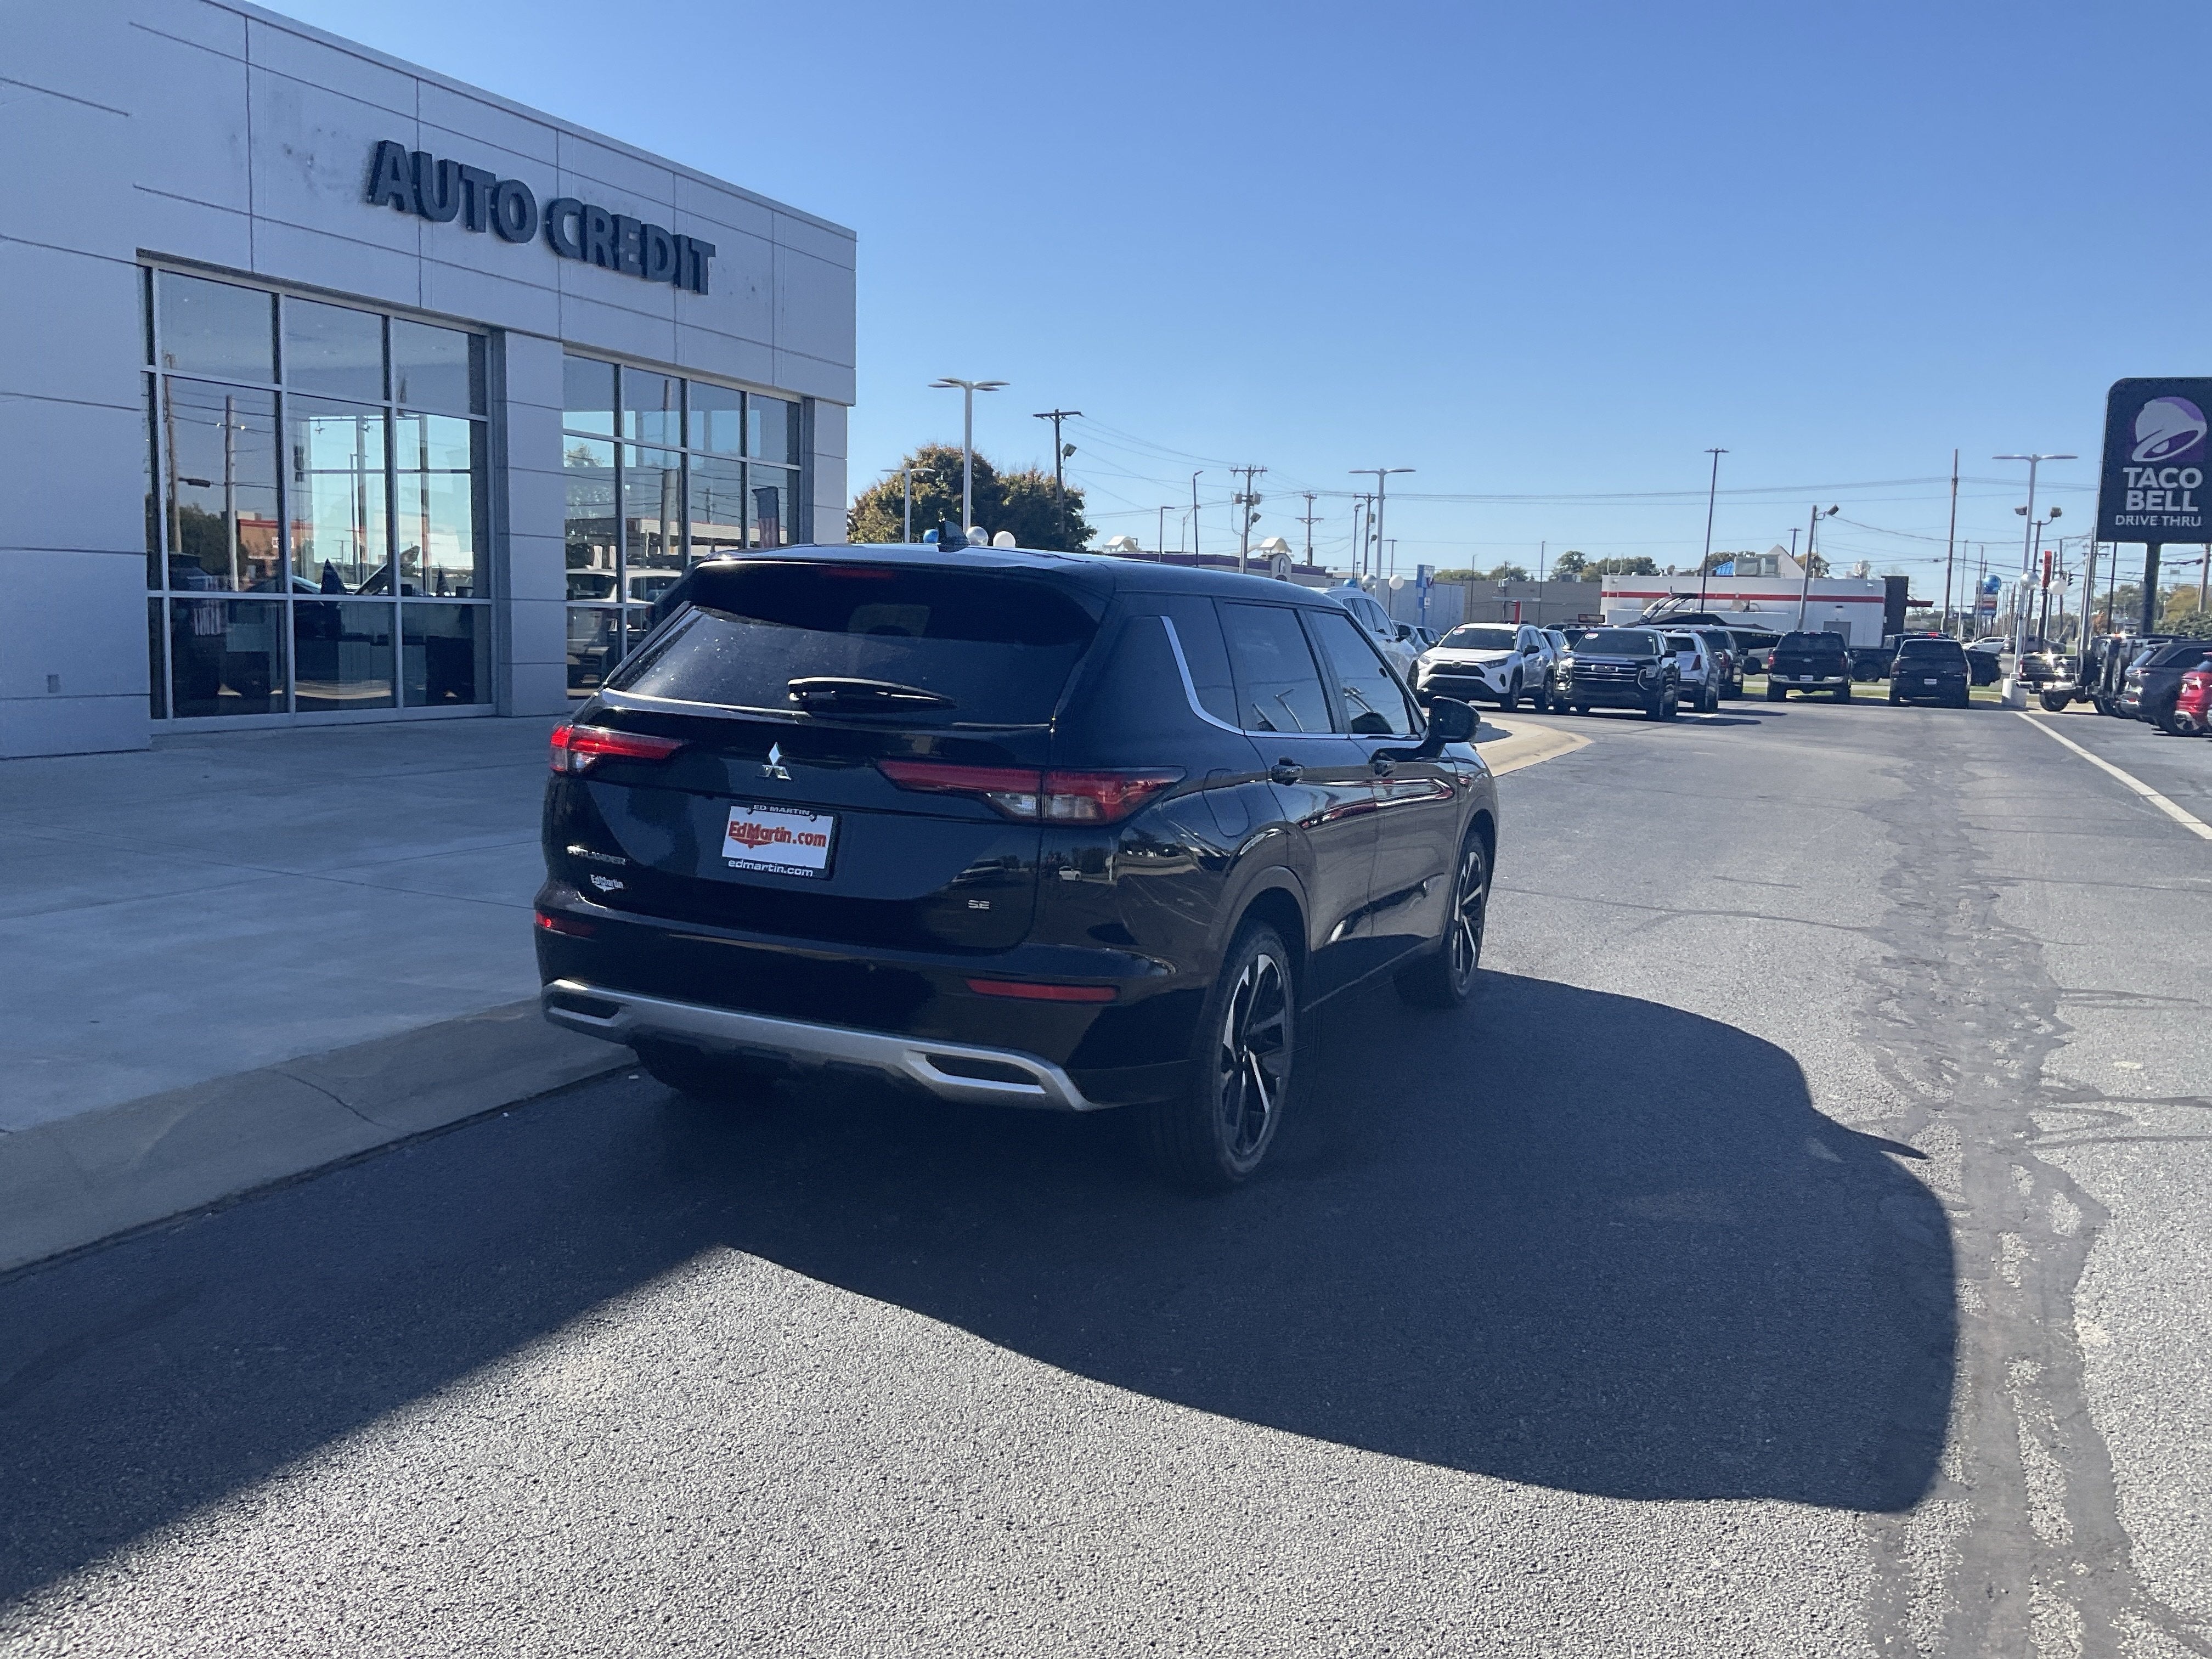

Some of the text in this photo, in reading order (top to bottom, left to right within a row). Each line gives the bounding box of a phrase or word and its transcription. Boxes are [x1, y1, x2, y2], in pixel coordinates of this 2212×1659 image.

[366, 140, 715, 295] AUTO CREDIT
[2123, 467, 2202, 488] TACO
[2126, 490, 2198, 511] BELL
[2115, 515, 2202, 527] DRIVE THRU
[769, 806, 810, 815] MARTIN
[728, 821, 827, 848] EdMartin.com
[729, 859, 813, 877] edmartin.com
[968, 900, 990, 909] SE
